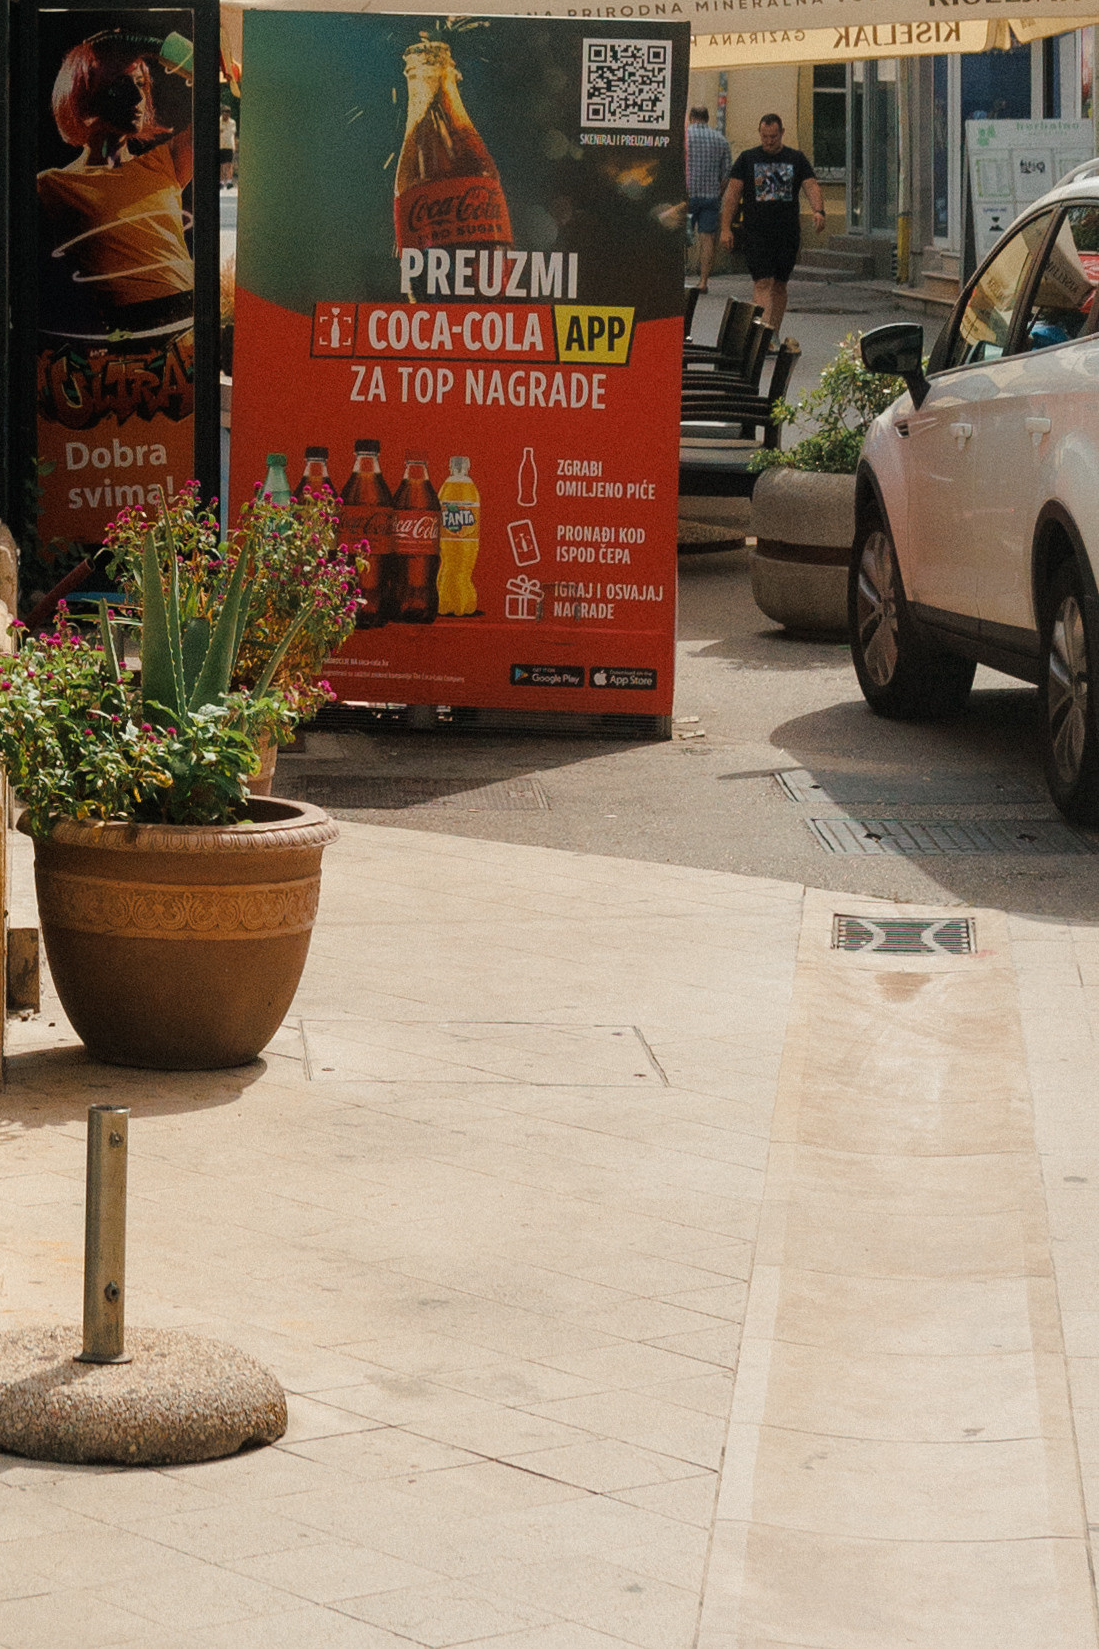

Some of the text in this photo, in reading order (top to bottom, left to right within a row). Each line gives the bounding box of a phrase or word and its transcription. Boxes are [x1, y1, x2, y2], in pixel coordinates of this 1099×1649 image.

[580, 134, 616, 146] SKENIRAJ
[621, 135, 653, 147] PREUZMI
[654, 136, 670, 148] APP
[400, 246, 579, 299] PREUZMI
[368, 309, 626, 352] COCA-COLA APP
[350, 365, 607, 410] ZA TOP NAGRADE
[65, 438, 168, 471] Dobra
[557, 459, 602, 477] ZGRABI
[68, 475, 175, 510] svima!
[556, 480, 656, 500] OMILJENO PIĆE
[557, 524, 646, 544] PRONAĐI KOD
[556, 543, 631, 565] ISPOD ČEPA
[554, 581, 593, 599] IGRAJ
[606, 583, 664, 602] OSVAJAJ
[532, 673, 580, 685] Google Play
[609, 675, 653, 687] App Store
